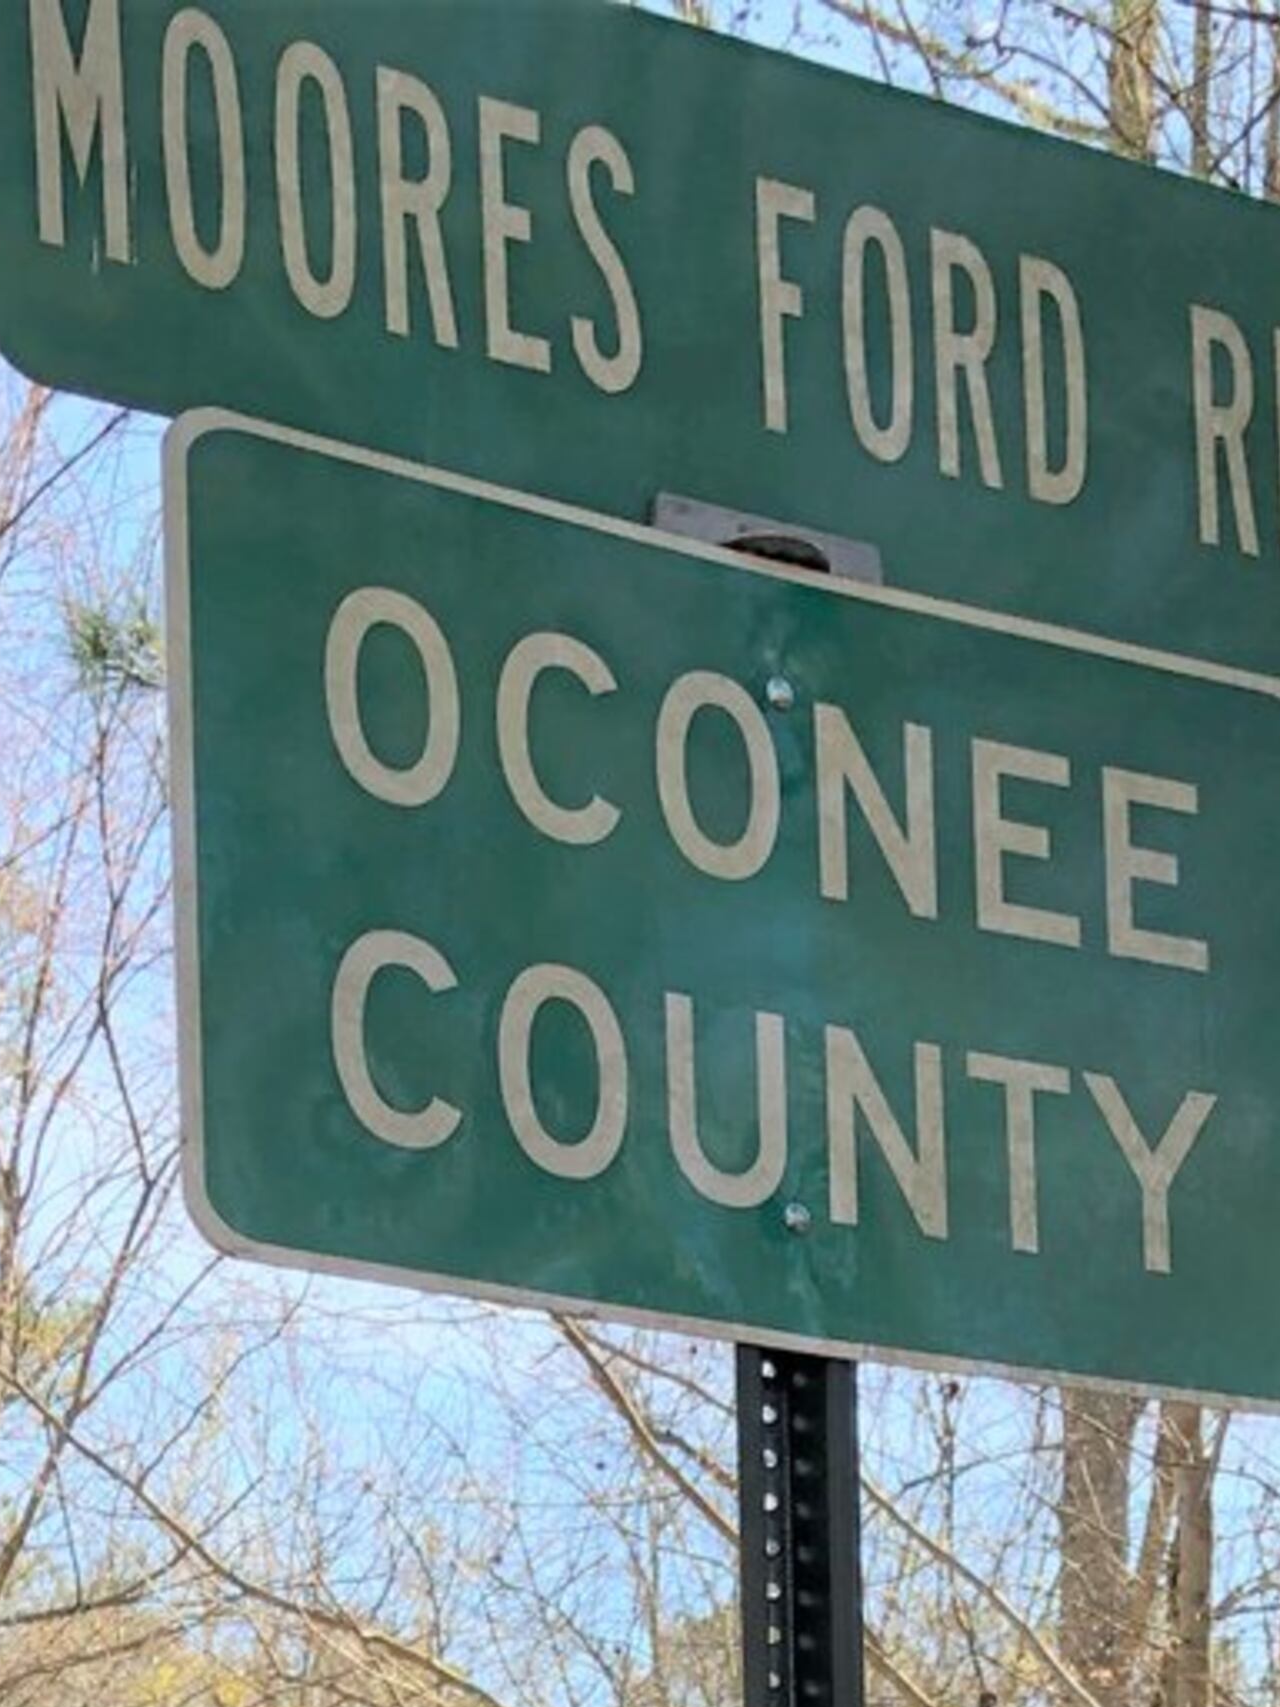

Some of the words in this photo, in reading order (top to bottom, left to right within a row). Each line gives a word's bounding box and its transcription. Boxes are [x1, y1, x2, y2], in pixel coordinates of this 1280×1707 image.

[31, 0, 643, 394] MOORES
[755, 178, 1088, 504] FORD
[325, 586, 1209, 972] OCONEE
[331, 930, 1217, 1273] COUNTY
